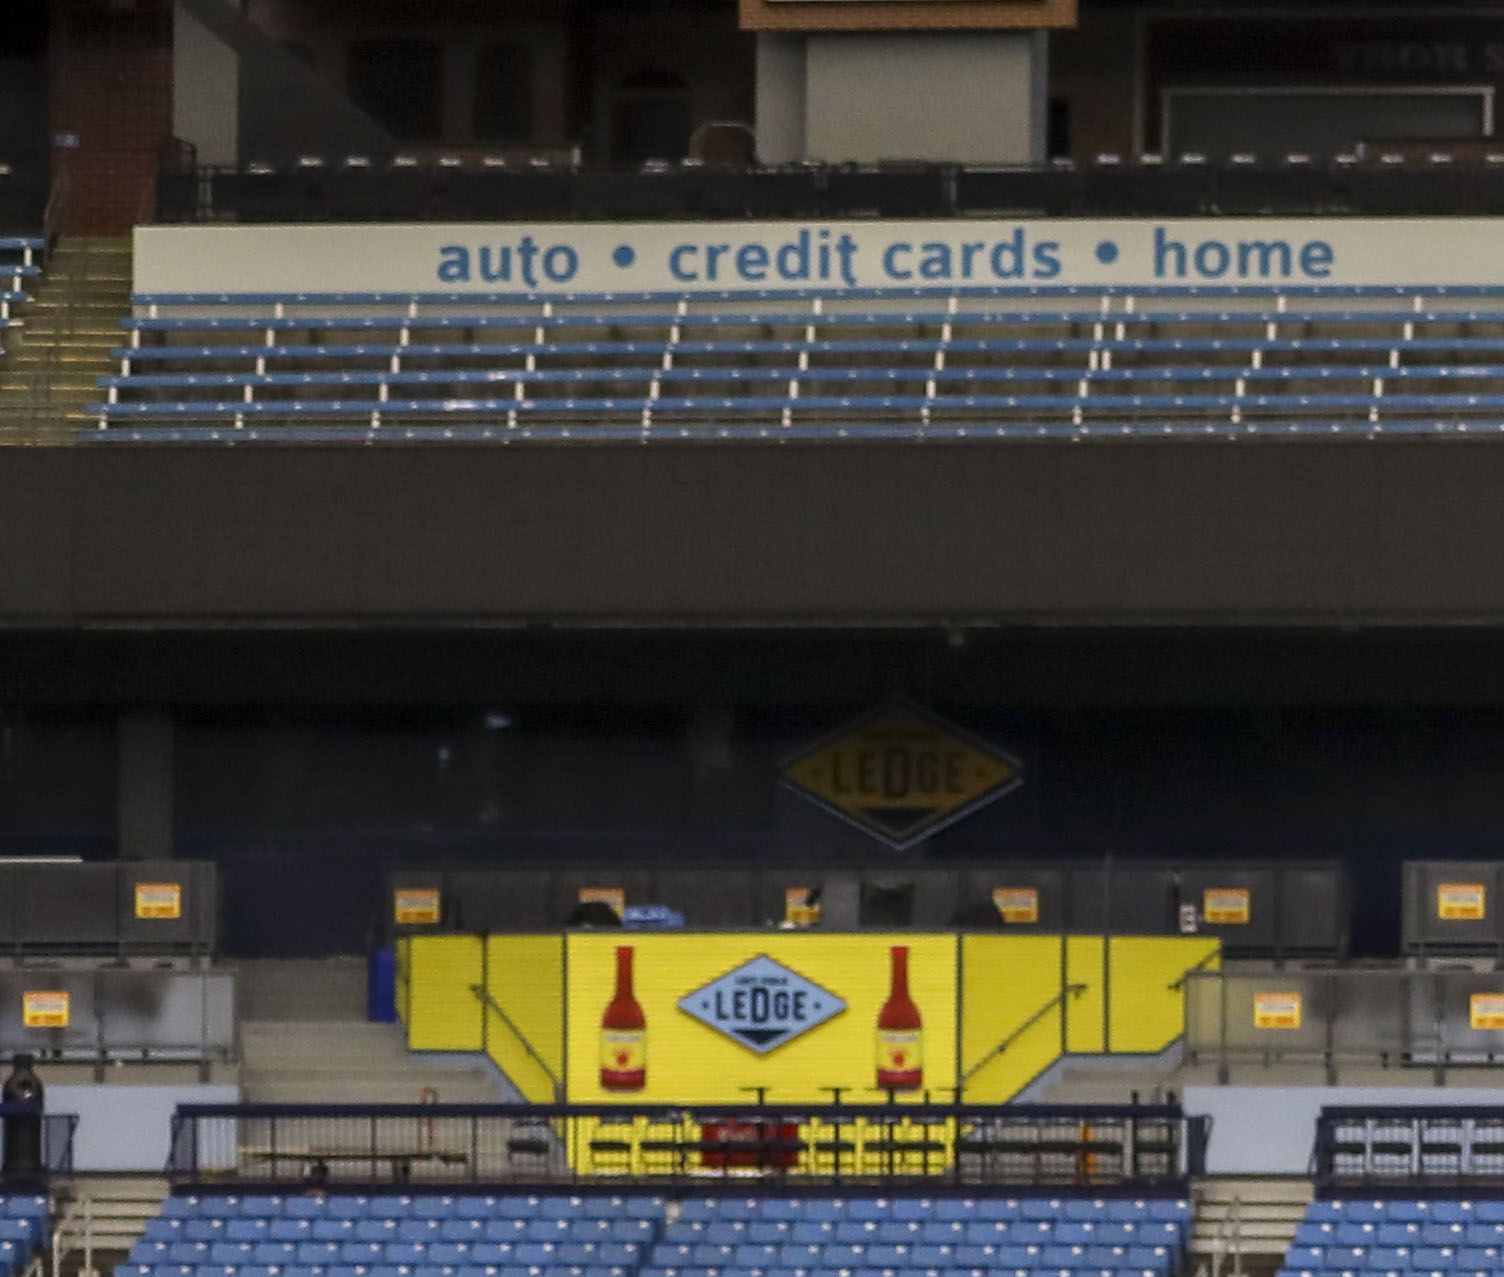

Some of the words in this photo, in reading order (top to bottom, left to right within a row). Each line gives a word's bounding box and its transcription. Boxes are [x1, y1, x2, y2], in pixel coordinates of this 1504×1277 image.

[437, 236, 579, 289] auto
[668, 229, 859, 287] credit
[883, 227, 1062, 280] cards
[1153, 227, 1335, 278] home
[715, 988, 808, 1024] LEDGE
